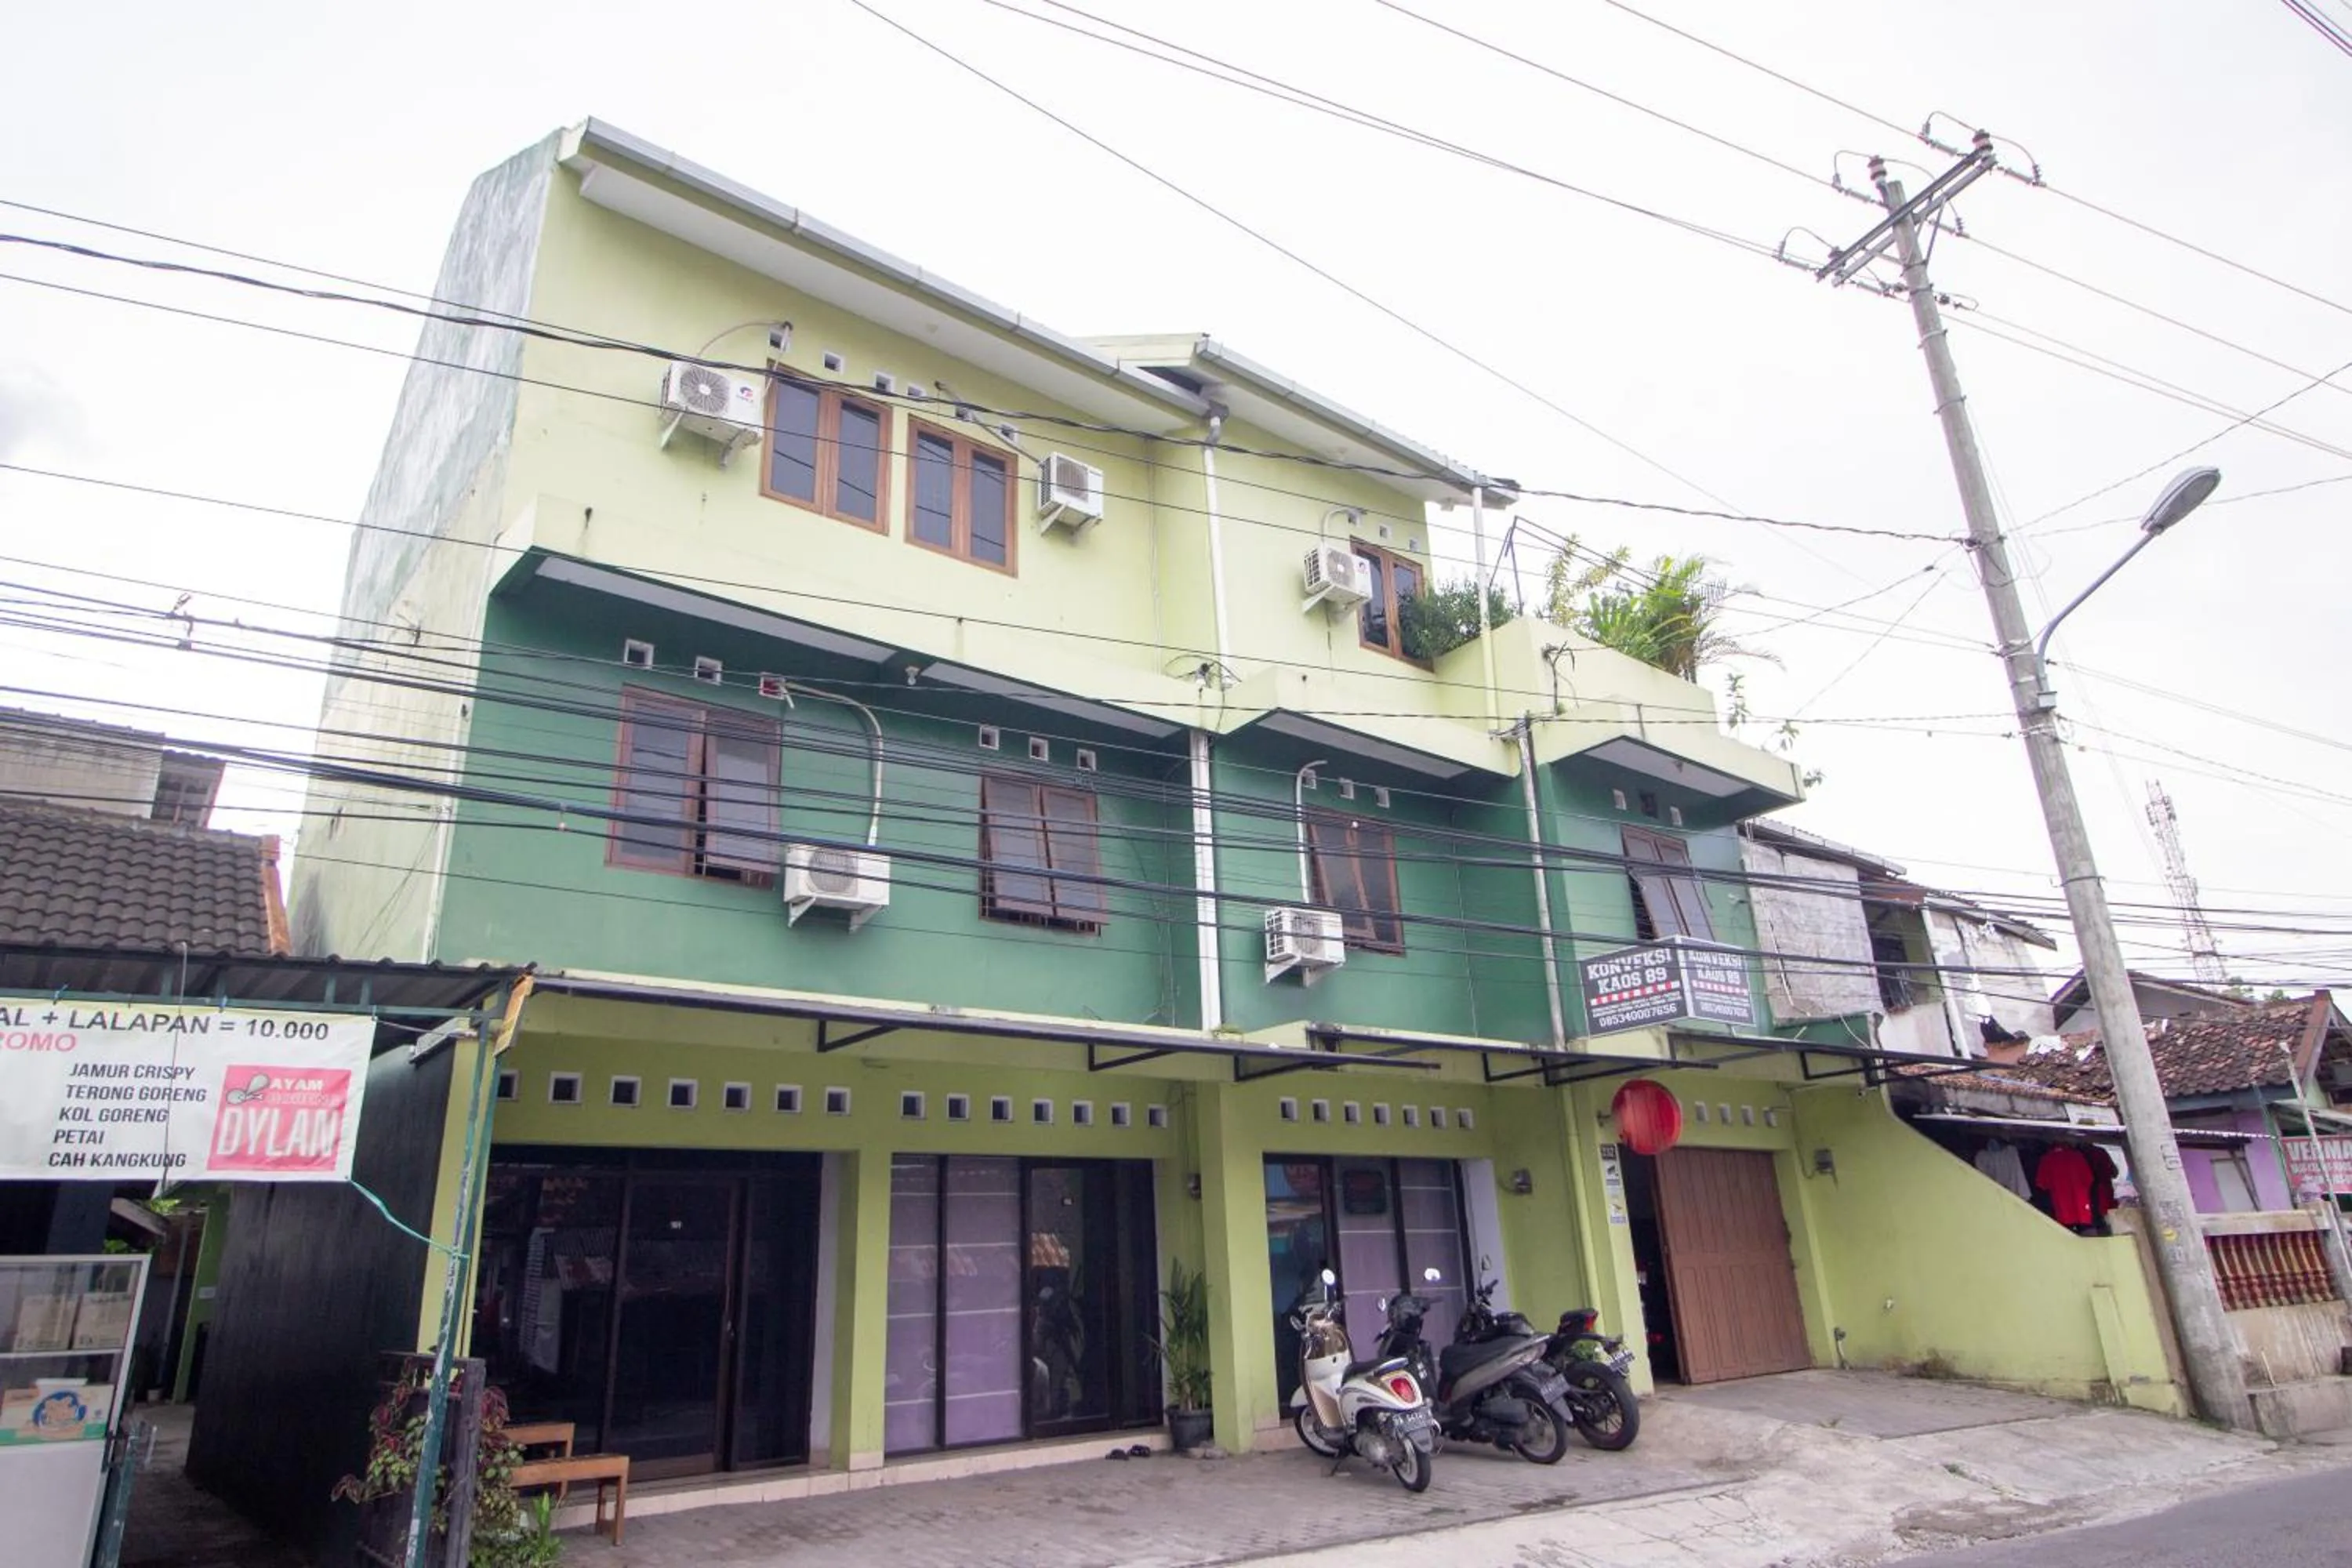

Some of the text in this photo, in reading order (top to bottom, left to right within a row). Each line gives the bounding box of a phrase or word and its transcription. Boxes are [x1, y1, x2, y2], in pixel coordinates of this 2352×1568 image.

[1587, 948, 1672, 979] KONVEKSI
[1598, 967, 1668, 994] KAOS 89
[69, 1010, 210, 1034] LALAPAN
[247, 1019, 329, 1040] 10.000
[0, 1032, 77, 1052] OMO
[70, 1064, 195, 1080] JAMUR CRISPY
[66, 1084, 207, 1102] TERONG GORENG
[270, 1078, 323, 1091] AYAM
[59, 1106, 169, 1123] KOL GORENG
[53, 1129, 105, 1145] PETAI
[216, 1106, 339, 1157] DYLAN
[49, 1151, 187, 1168] CAH KANGKUNG
